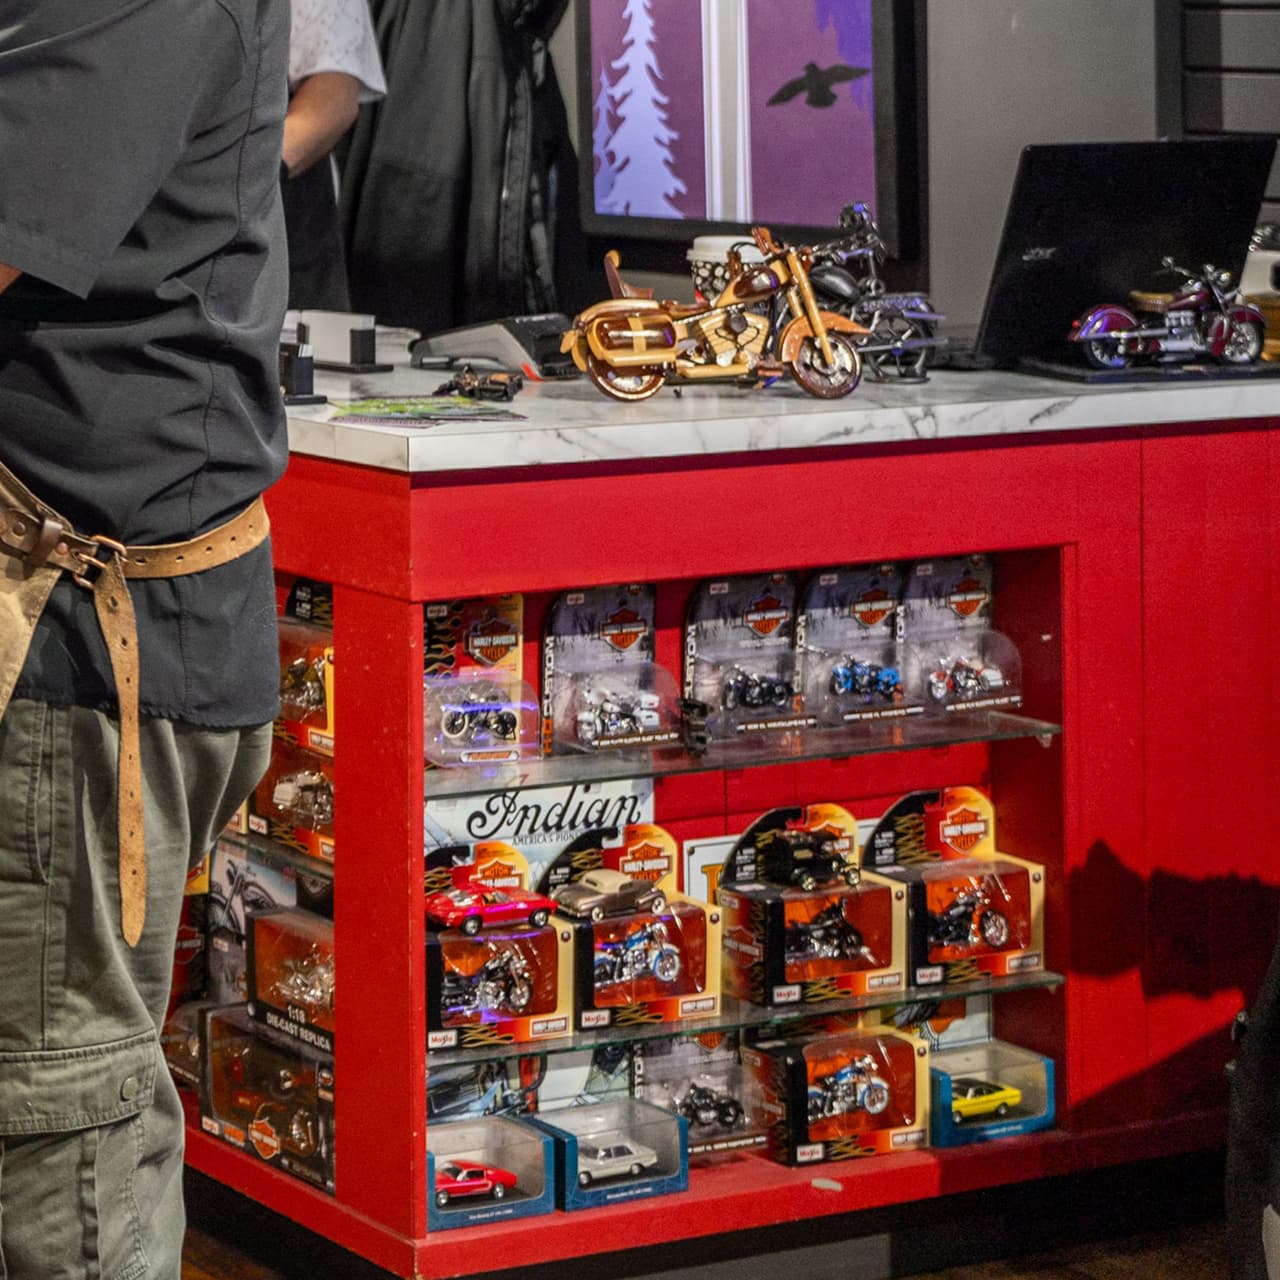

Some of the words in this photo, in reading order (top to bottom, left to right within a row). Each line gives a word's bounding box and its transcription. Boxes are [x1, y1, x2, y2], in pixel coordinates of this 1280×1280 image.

[543, 636, 555, 718] CUSTOM
[466, 782, 642, 840] Indian
[266, 1012, 298, 1037] DIE-CAST
[299, 1027, 331, 1052] REPLICA
[288, 1005, 306, 1024] 1:18
